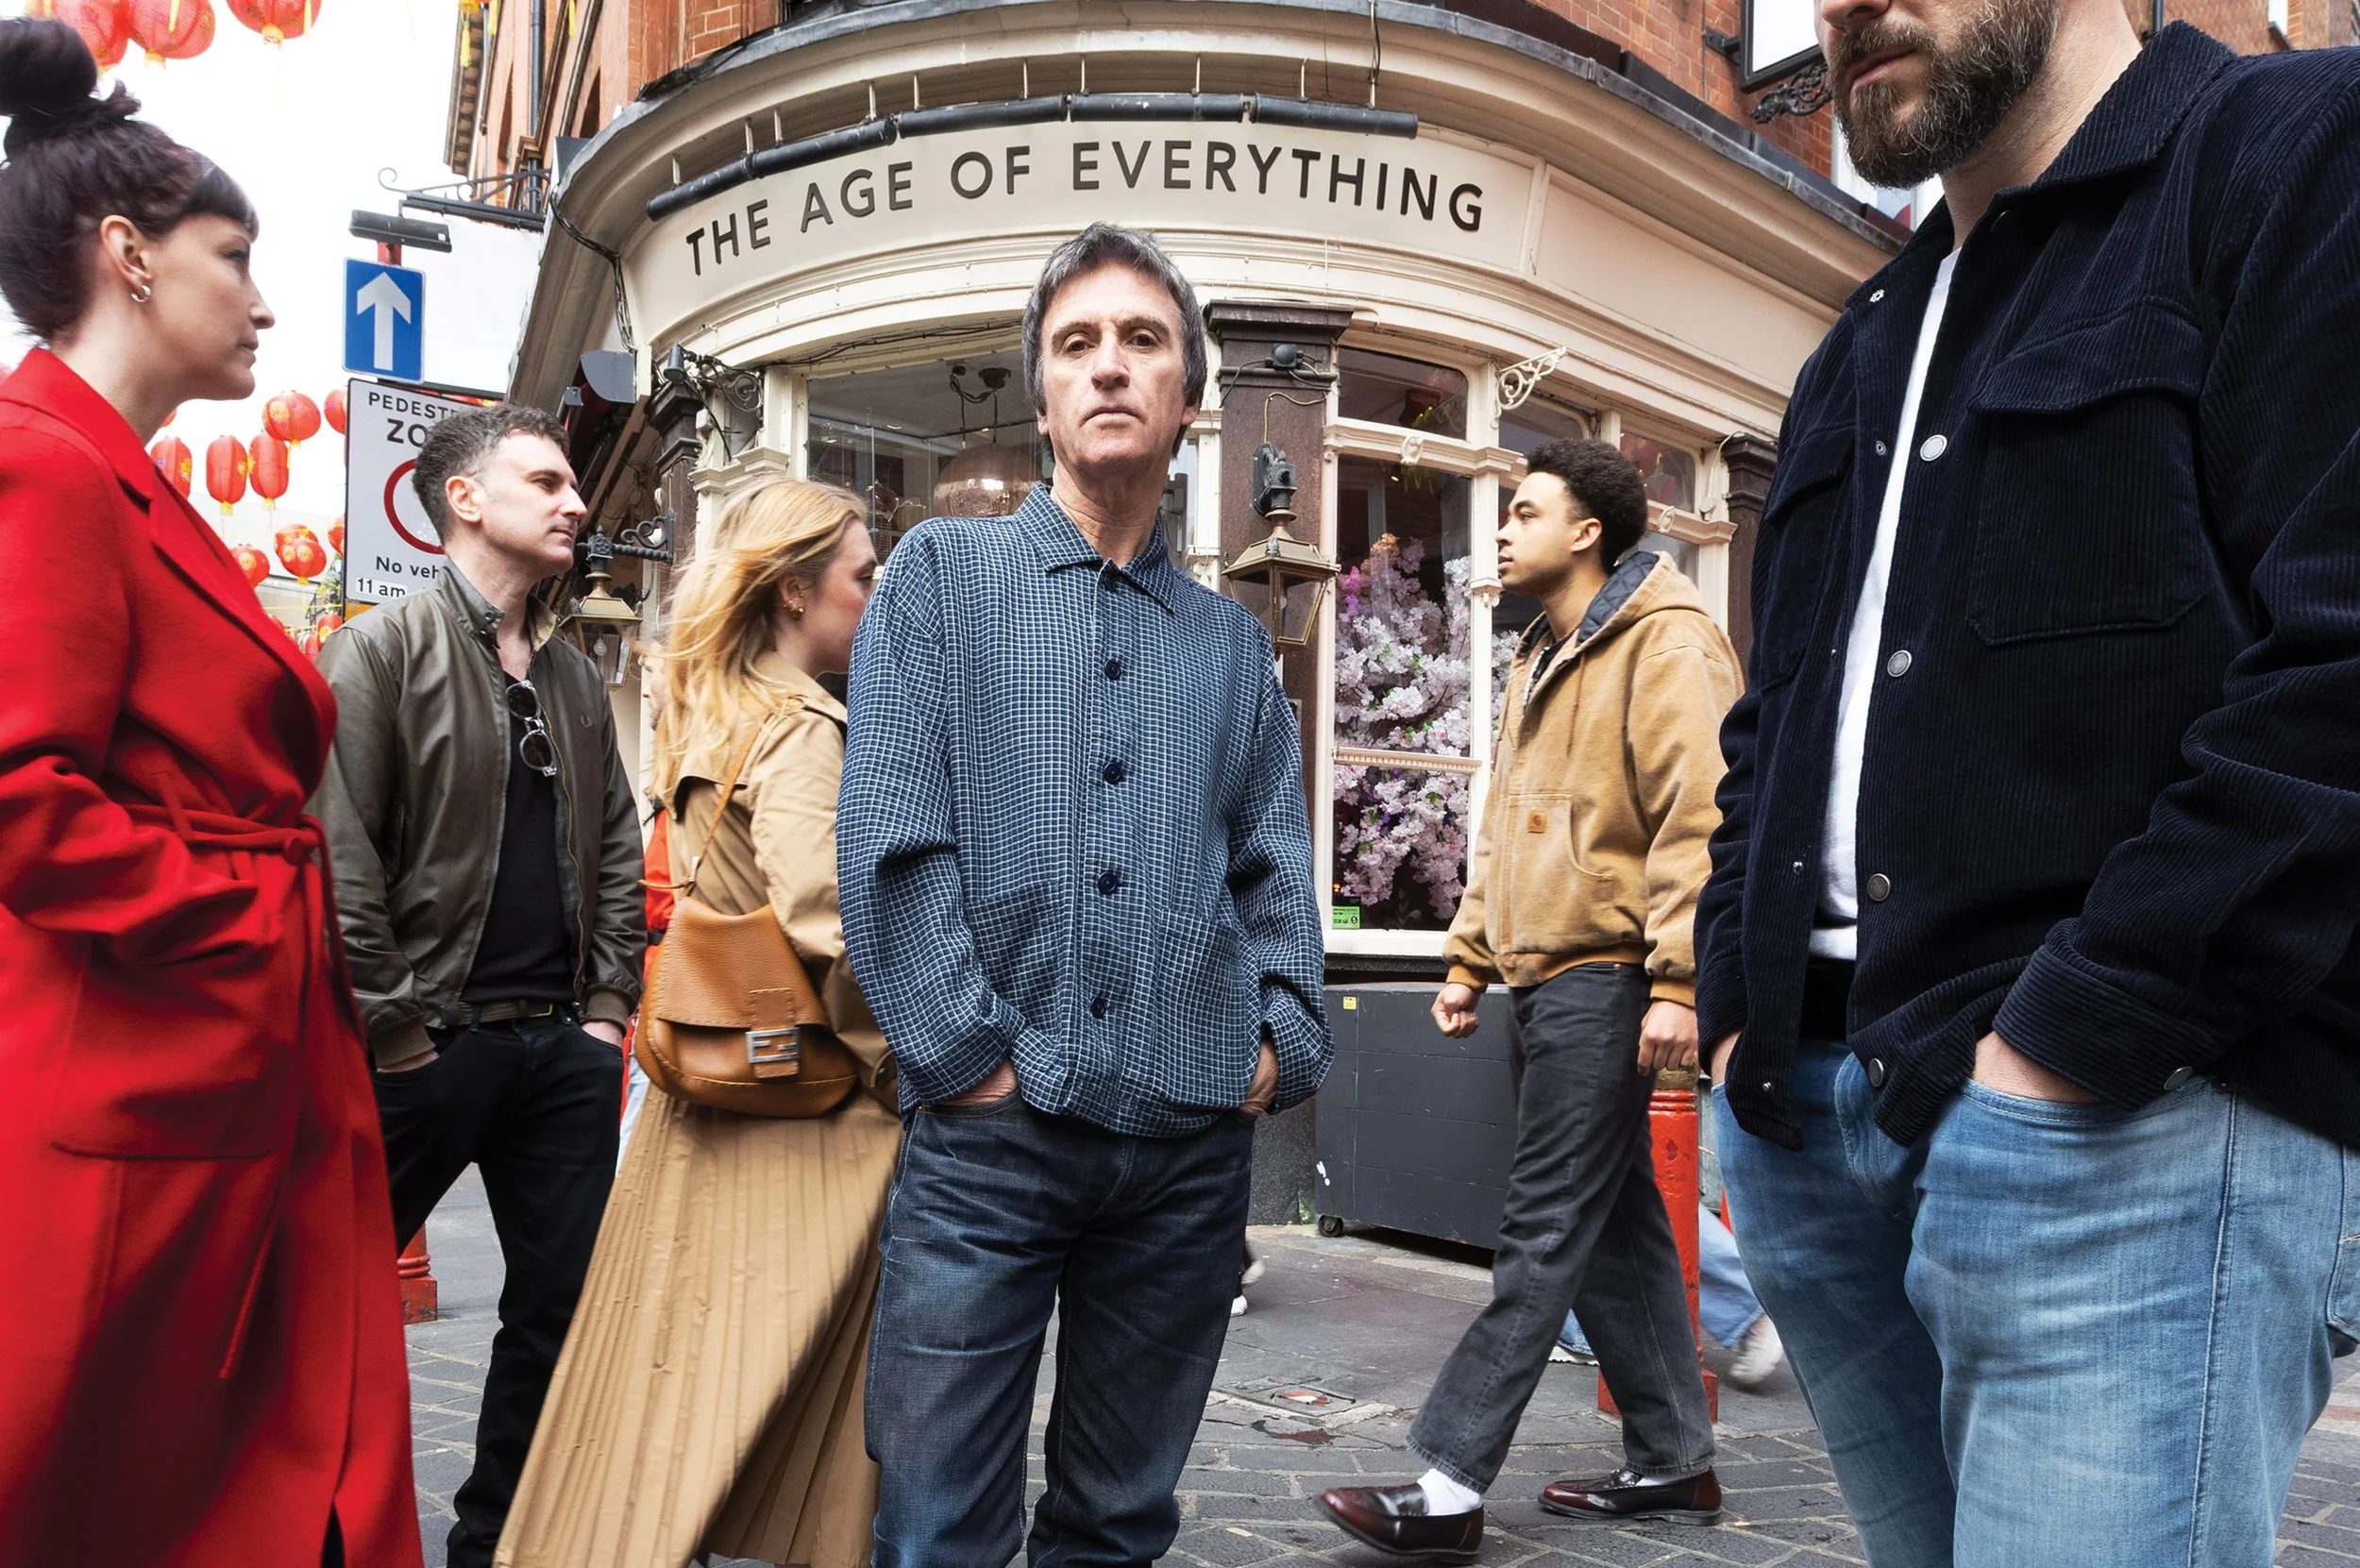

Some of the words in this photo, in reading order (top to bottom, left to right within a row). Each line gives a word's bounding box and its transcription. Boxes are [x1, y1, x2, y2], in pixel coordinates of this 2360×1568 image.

[685, 199, 772, 277] THE
[801, 160, 914, 234] AGE
[951, 145, 1031, 200] OF
[1072, 140, 1484, 233] EVERYTHING
[376, 555, 402, 574] No
[358, 578, 373, 594] 11
[379, 584, 406, 598] am
